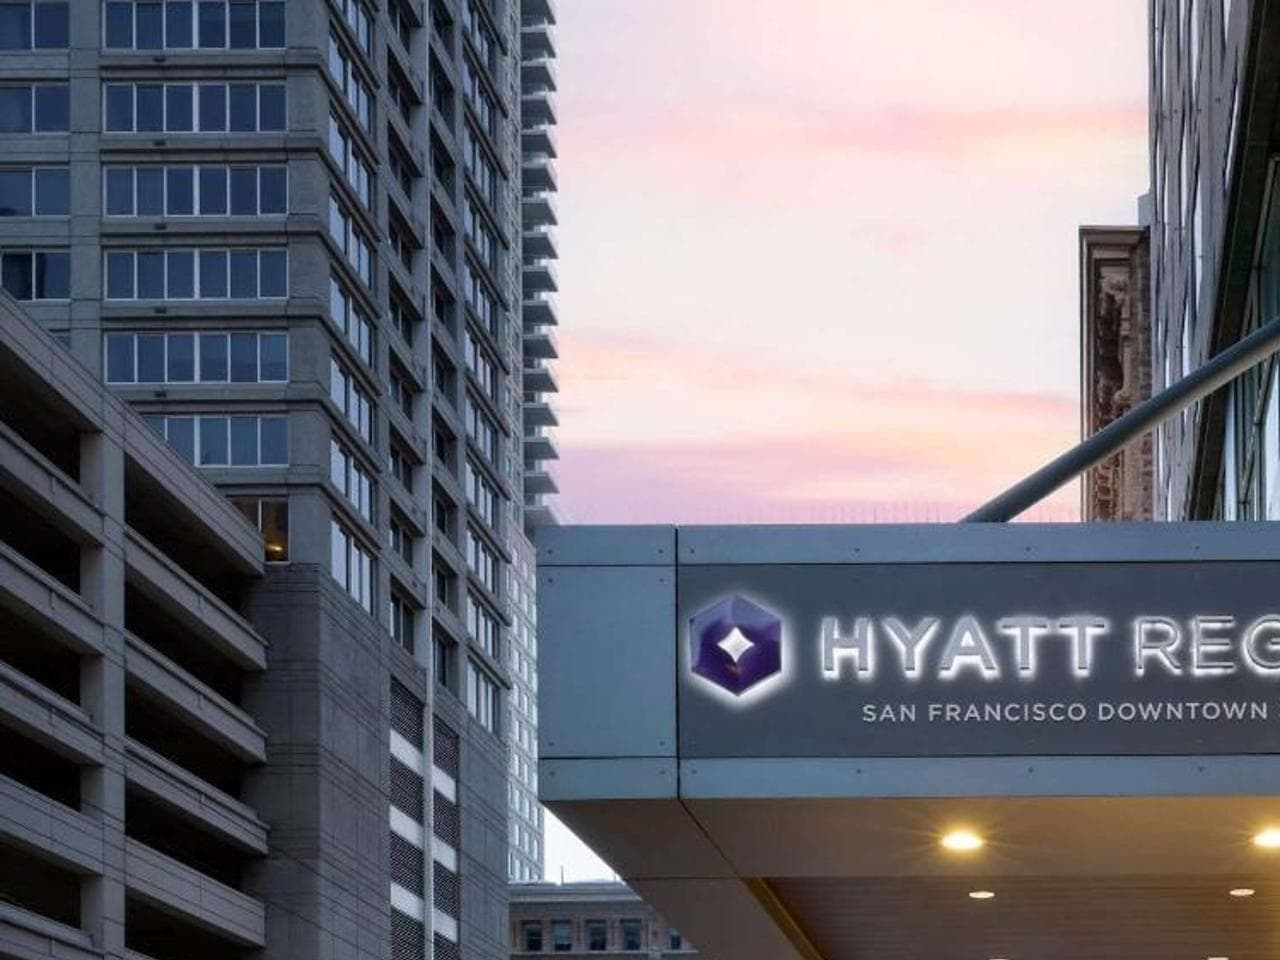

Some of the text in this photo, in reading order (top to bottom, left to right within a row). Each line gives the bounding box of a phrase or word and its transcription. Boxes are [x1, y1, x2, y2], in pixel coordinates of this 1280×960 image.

[820, 615, 1106, 676] HYATT
[862, 704, 916, 722] SAN
[928, 703, 1086, 722] FRANCISCO
[1098, 702, 1268, 721] DOWNTOWN
